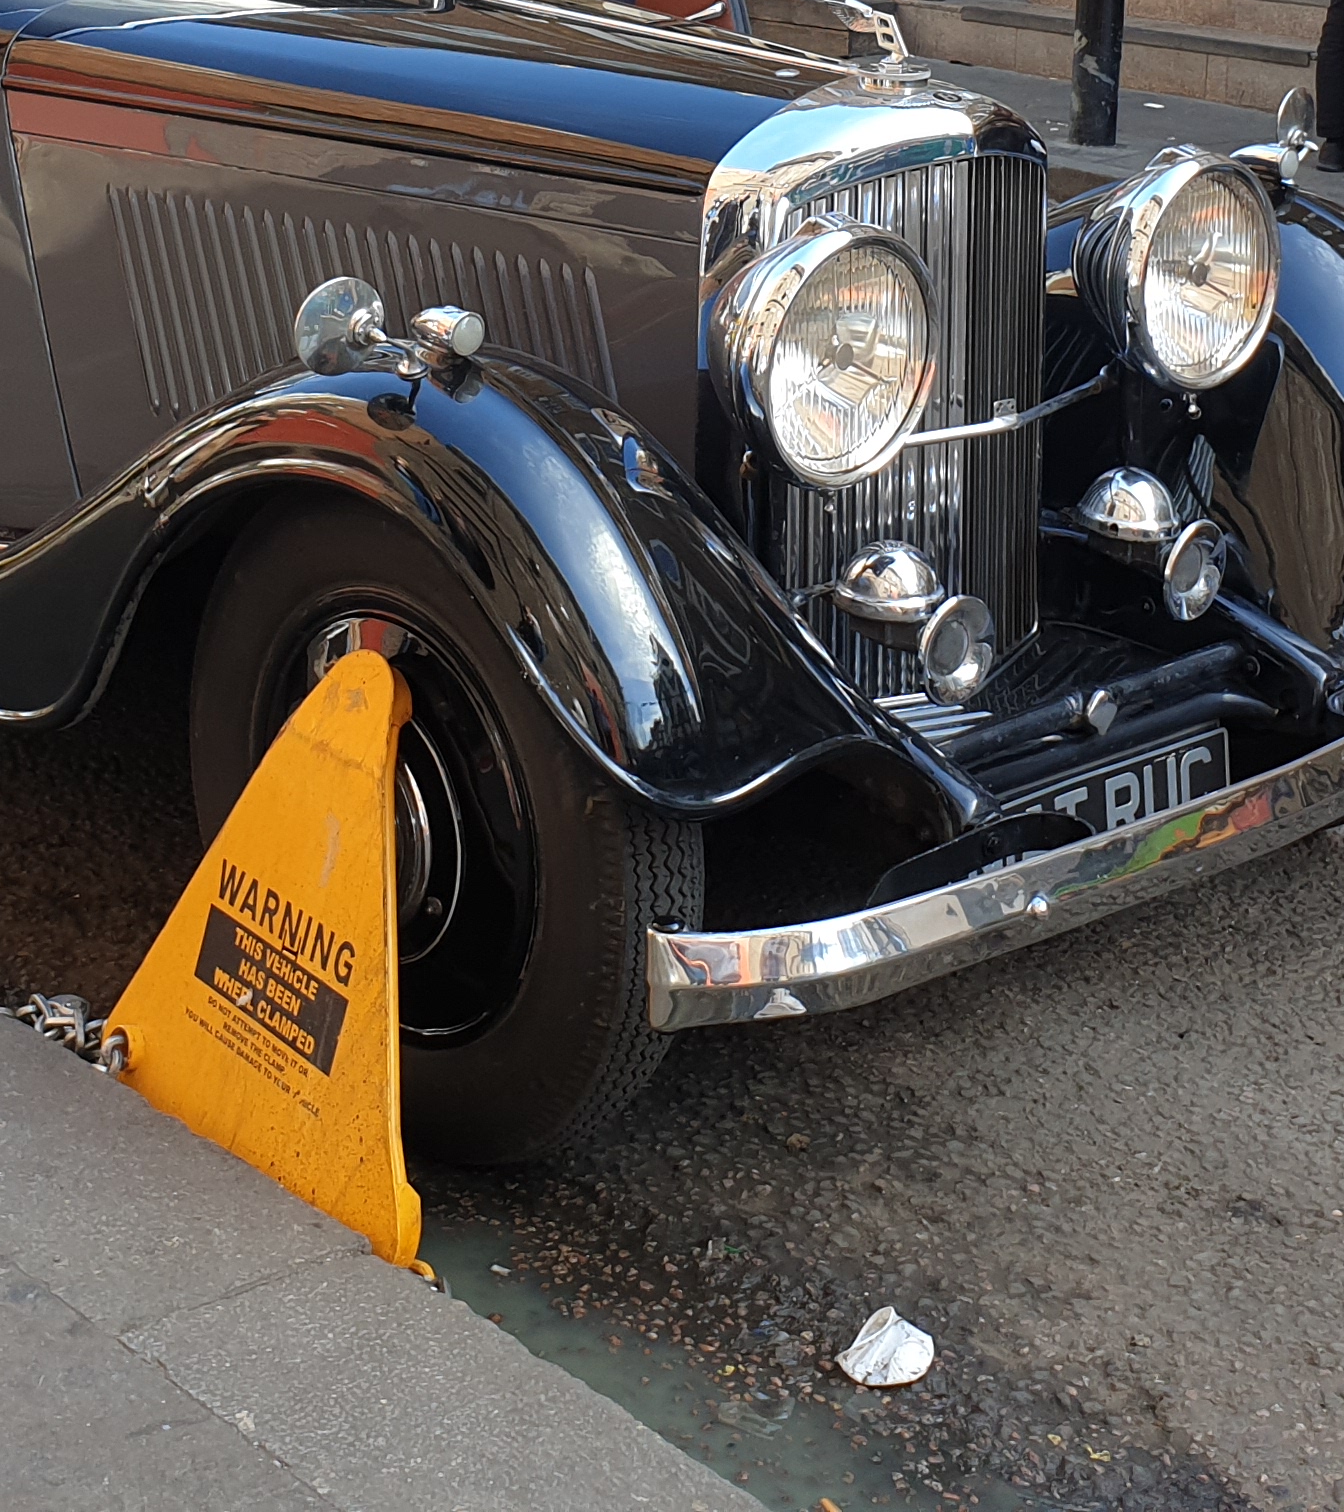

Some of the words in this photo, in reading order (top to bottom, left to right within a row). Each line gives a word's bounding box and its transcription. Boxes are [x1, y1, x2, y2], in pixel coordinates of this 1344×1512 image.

[219, 859, 356, 987] WARNING
[235, 927, 264, 960] THIS
[208, 995, 218, 1008] DO
[239, 959, 266, 989] HAS
[266, 978, 301, 1016] BEEN
[257, 999, 315, 1055] CLAMPED
